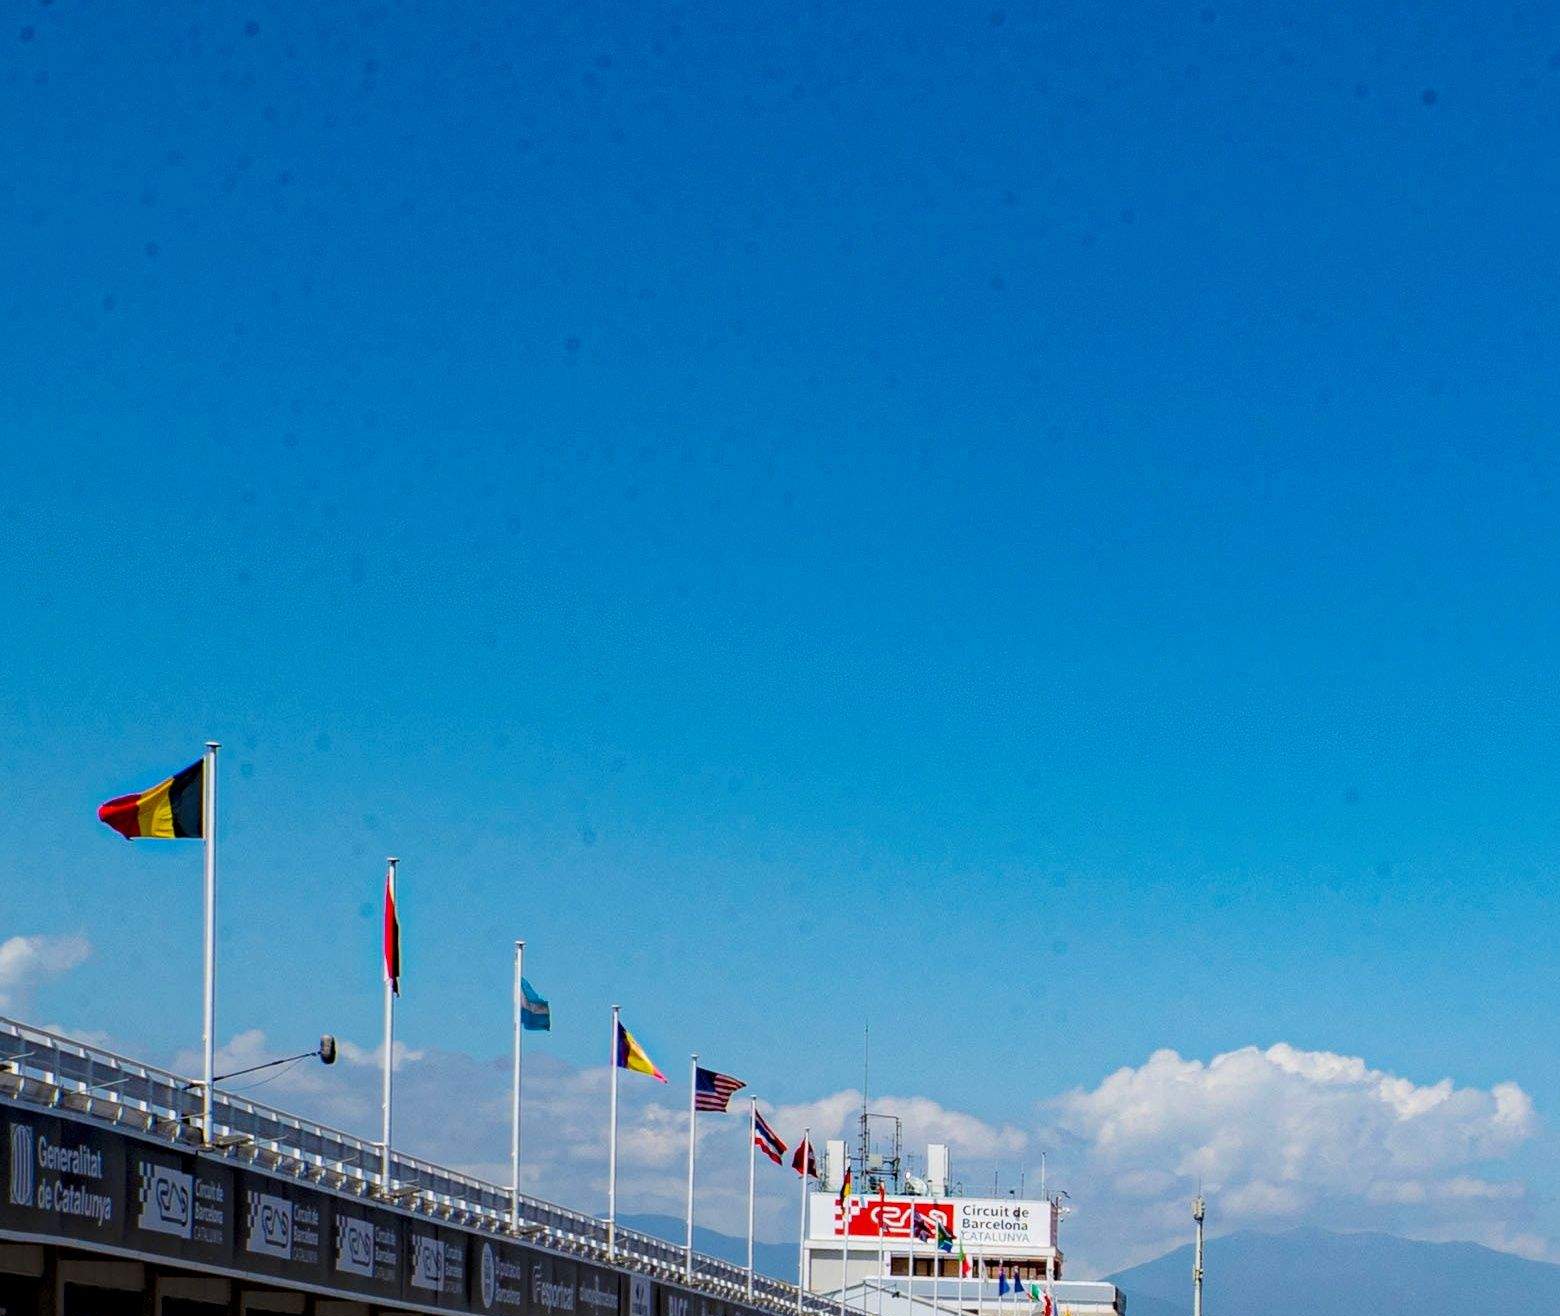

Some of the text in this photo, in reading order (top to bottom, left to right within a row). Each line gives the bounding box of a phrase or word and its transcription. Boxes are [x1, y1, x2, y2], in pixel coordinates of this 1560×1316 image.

[38, 1136, 102, 1179] Generalitat
[37, 1178, 112, 1228] de Catalunya
[962, 1205, 1029, 1218] Circuit de
[962, 1218, 1028, 1231] Barcelona
[962, 1231, 1031, 1243] CATALUNYA
